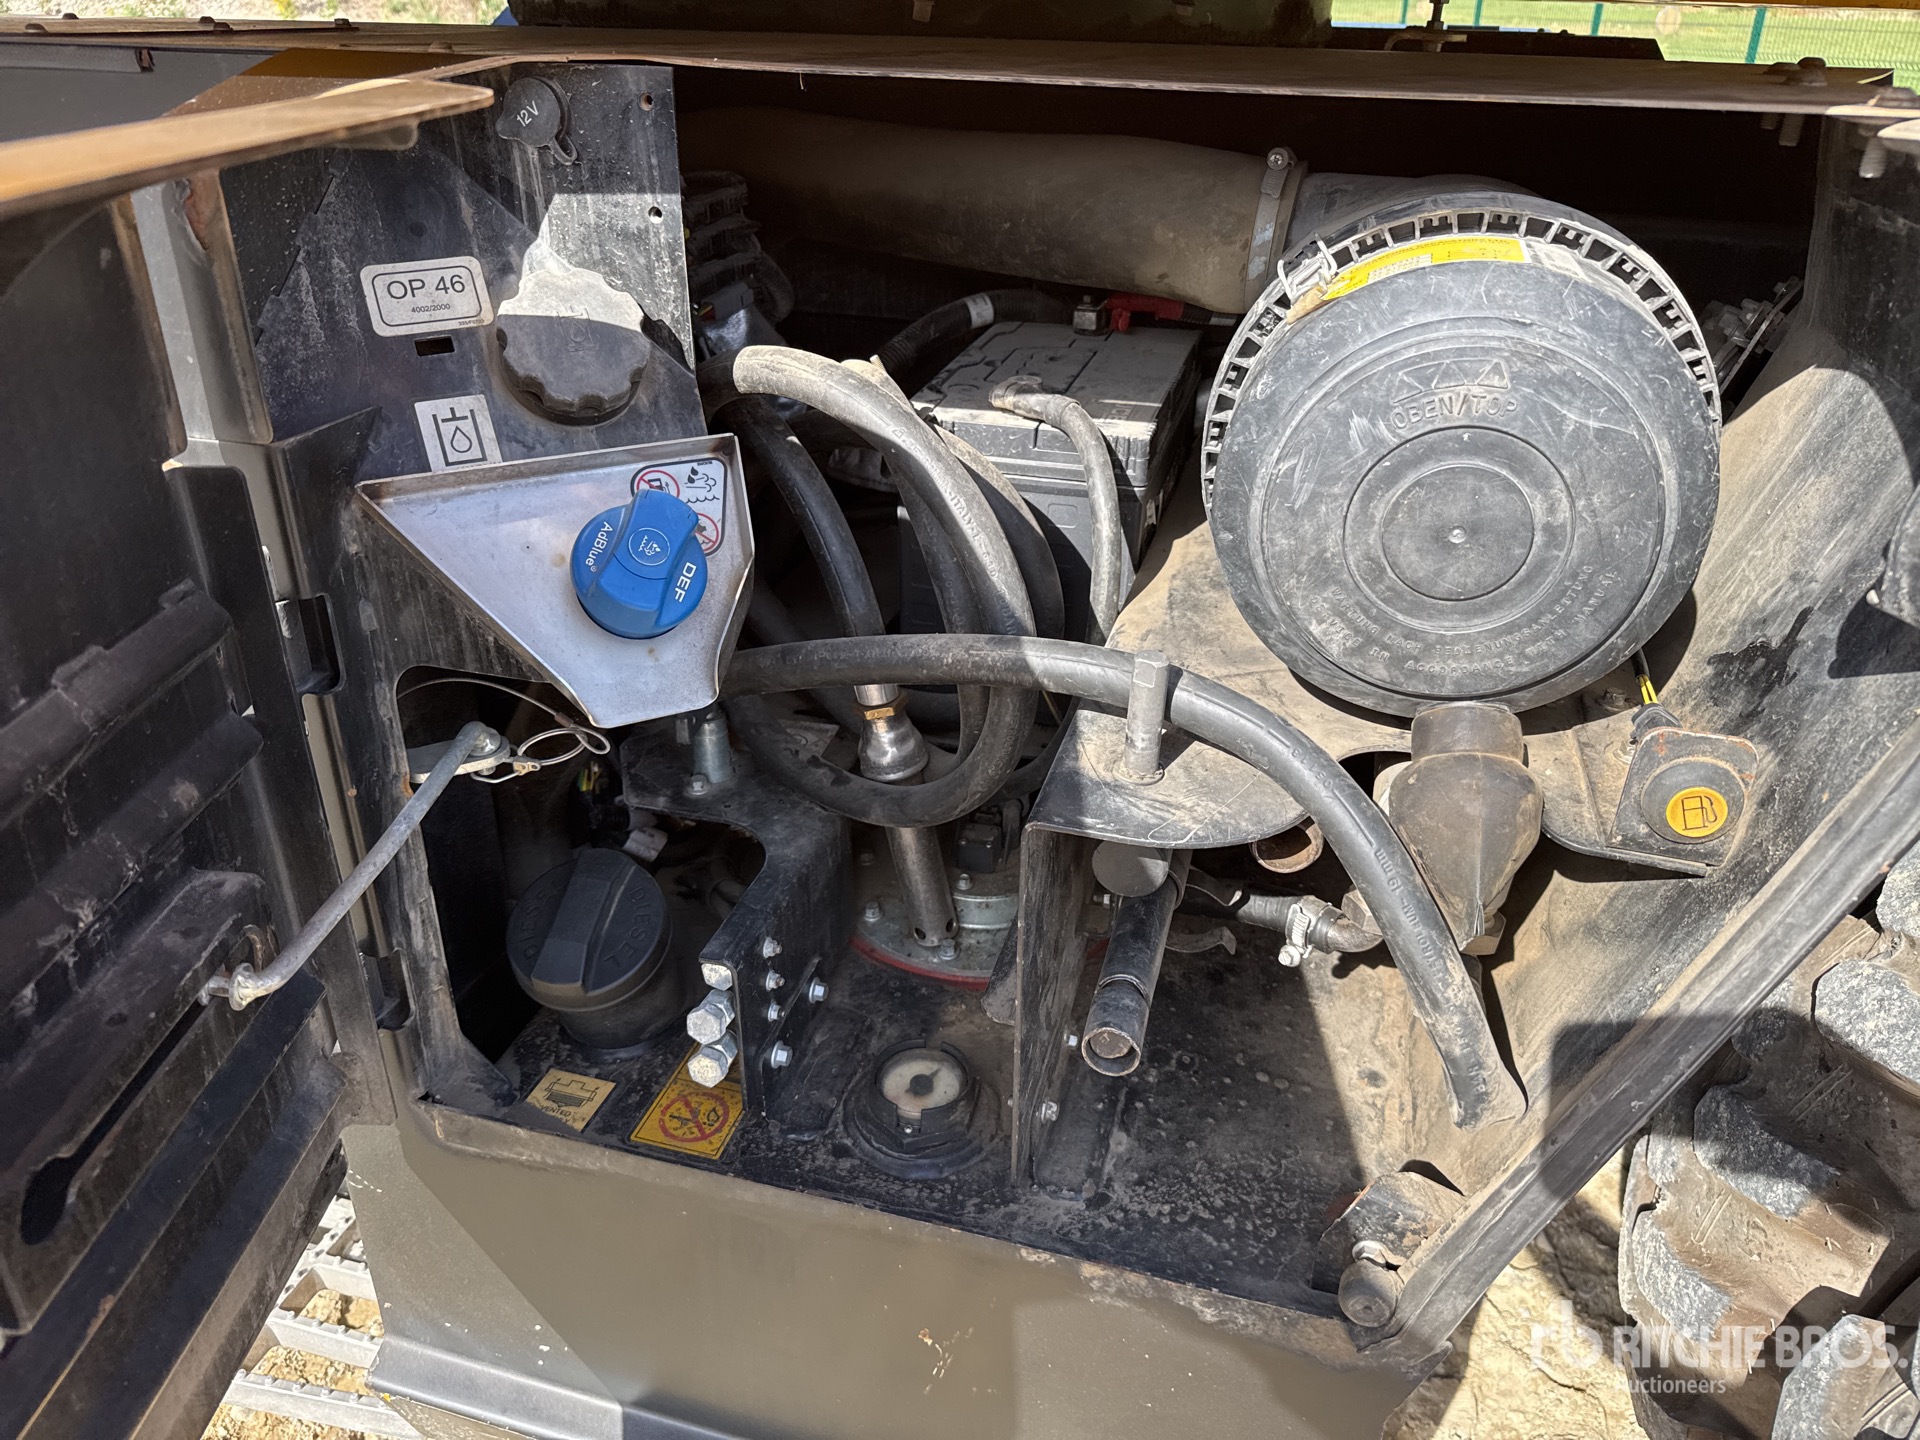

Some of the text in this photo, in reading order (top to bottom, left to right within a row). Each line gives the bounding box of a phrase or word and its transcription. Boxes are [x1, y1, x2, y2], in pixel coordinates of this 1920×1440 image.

[386, 274, 466, 300] OP 46
[411, 303, 451, 314] 4002/2000
[1390, 392, 1518, 430] OBEN/TOP
[674, 561, 697, 603] DEF
[602, 886, 651, 968] DIESEL
[541, 1105, 572, 1117] VENTED
